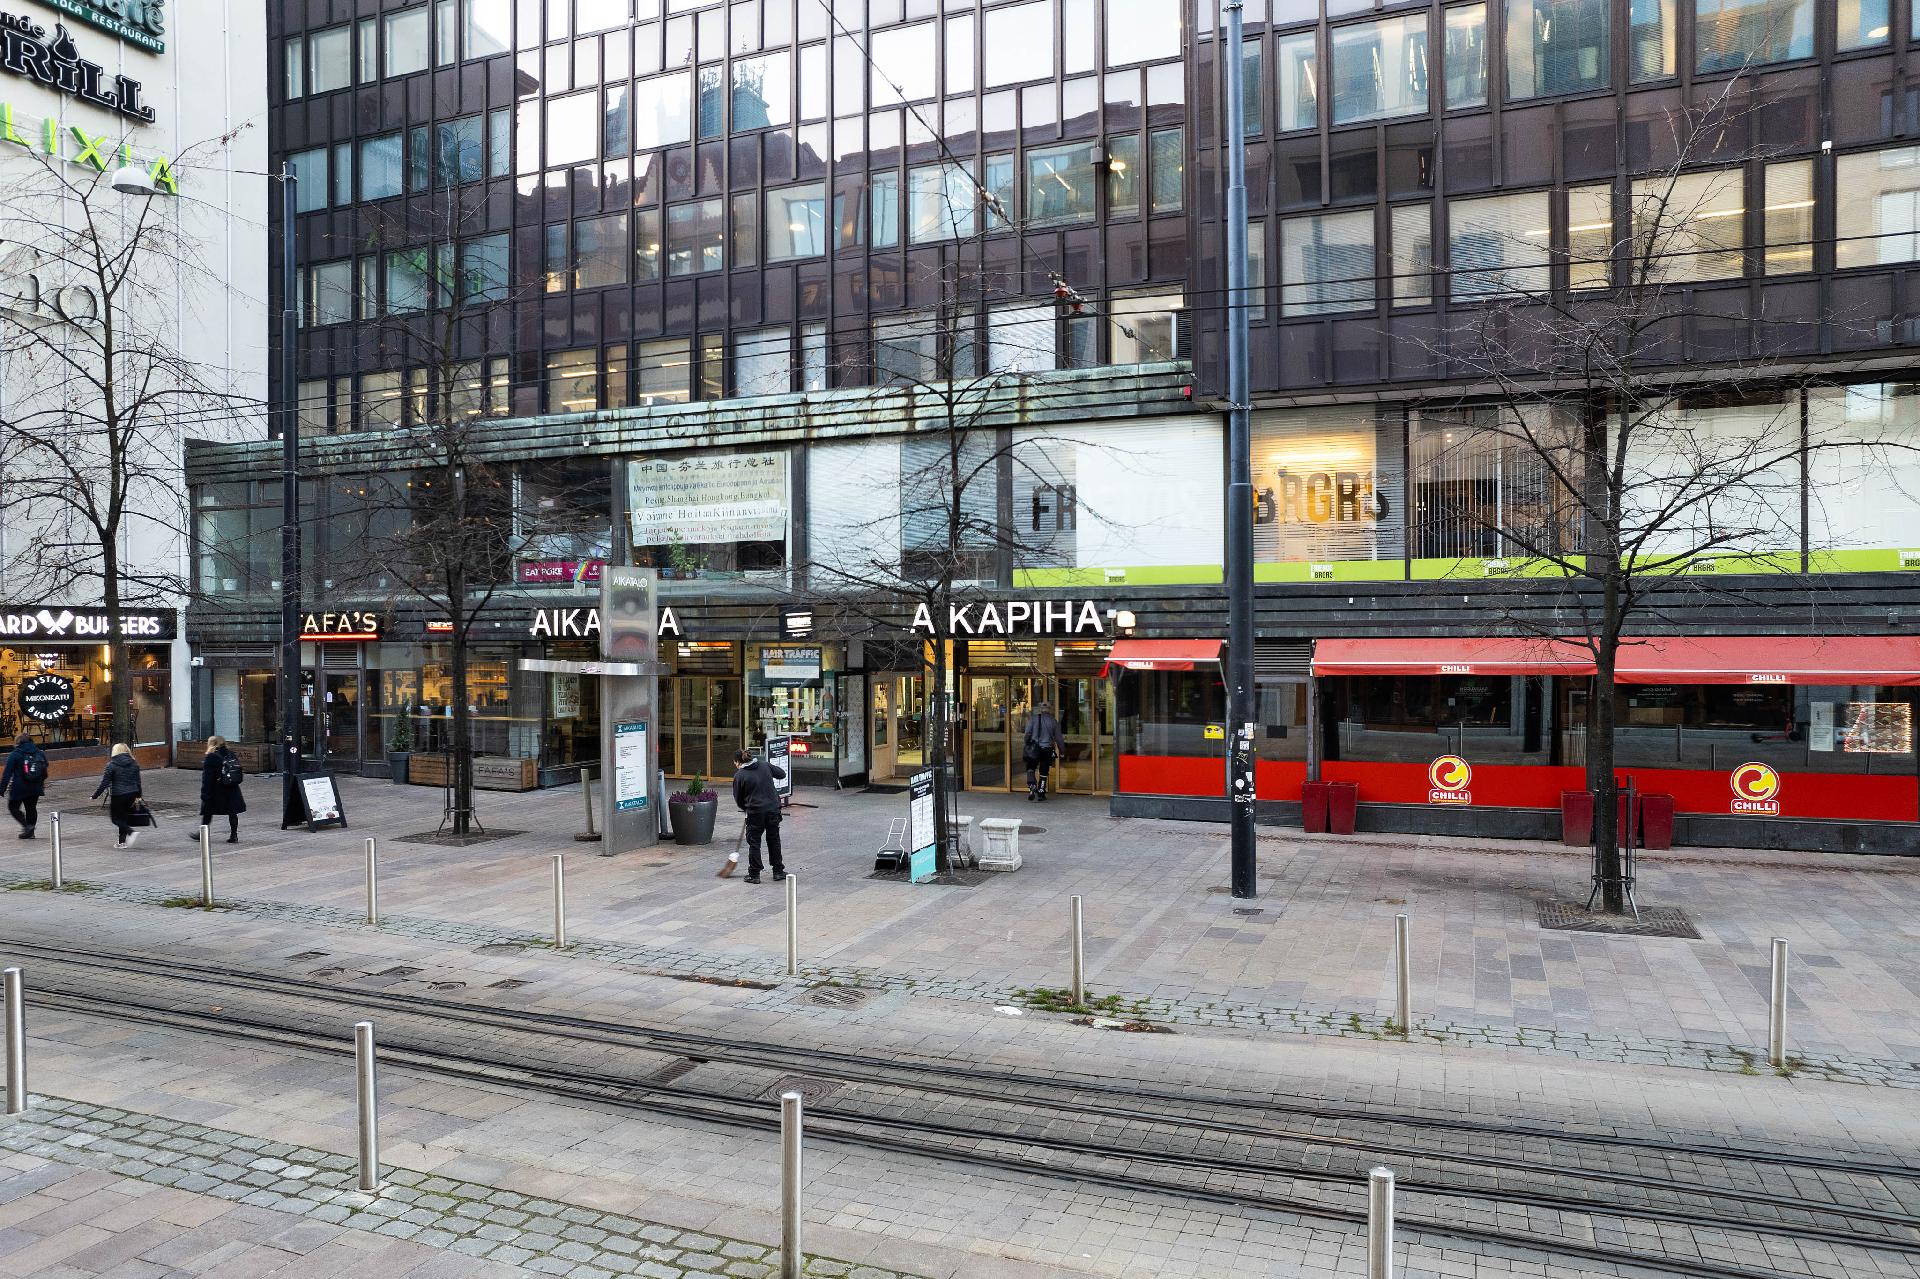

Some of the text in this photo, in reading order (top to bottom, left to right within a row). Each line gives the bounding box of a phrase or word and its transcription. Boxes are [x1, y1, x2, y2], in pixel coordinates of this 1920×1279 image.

[0, 11, 45, 38] nde
[91, 13, 164, 51] RESTAURANT
[0, 24, 156, 123] RILL
[525, 568, 539, 577] EAT
[541, 567, 563, 576] POKE
[612, 576, 648, 588] AIKATALO
[300, 612, 378, 633] AFA'S
[910, 600, 1104, 634] AKAPIHA
[762, 649, 784, 659] HAIR
[1127, 661, 1154, 669] CHILLI
[27, 675, 69, 691] BASTARD
[1751, 674, 1786, 682] CHILLI
[25, 693, 70, 702] MIKONKATU
[27, 704, 69, 720] BURGERS
[1431, 791, 1468, 801] CHILLI
[1733, 801, 1777, 811] CHILLI
